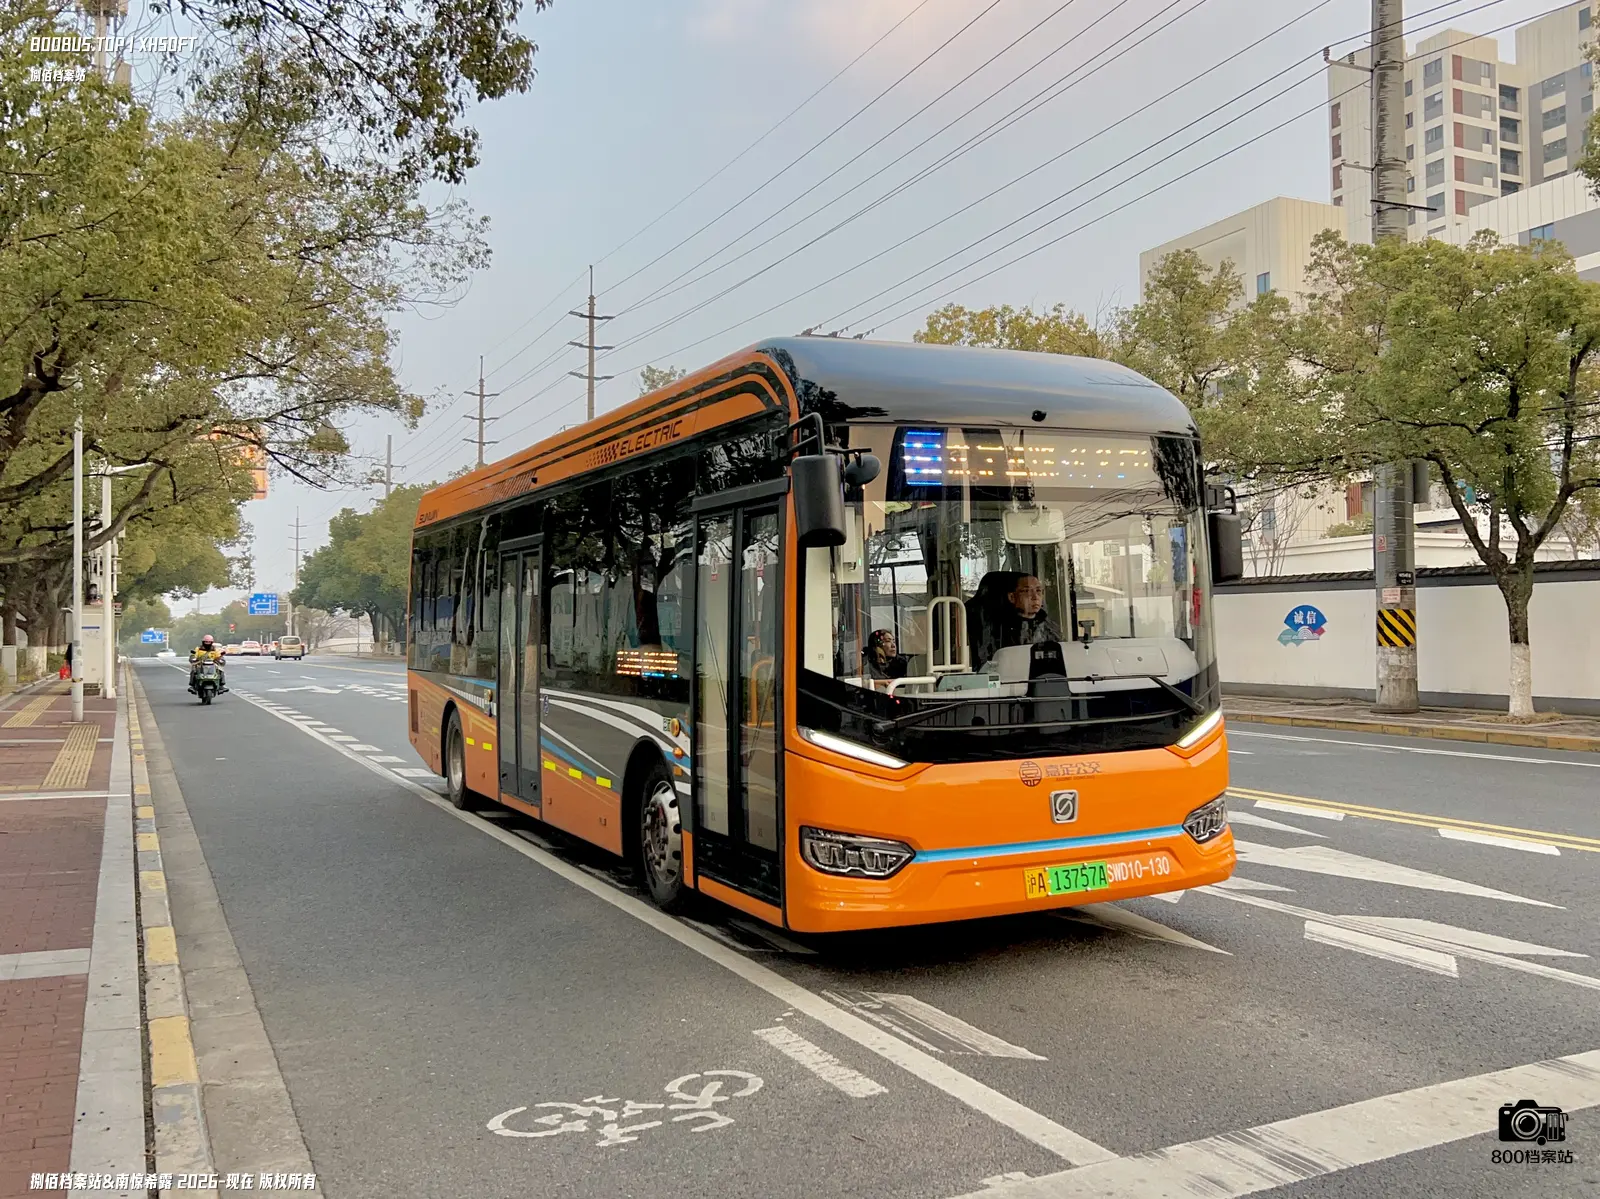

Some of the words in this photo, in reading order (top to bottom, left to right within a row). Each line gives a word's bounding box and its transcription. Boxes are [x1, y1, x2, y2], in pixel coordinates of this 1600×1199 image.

[620, 419, 683, 456] ELECTRIC
[1293, 610, 1317, 625] 诚信
[1107, 855, 1170, 883] SWD10-130
